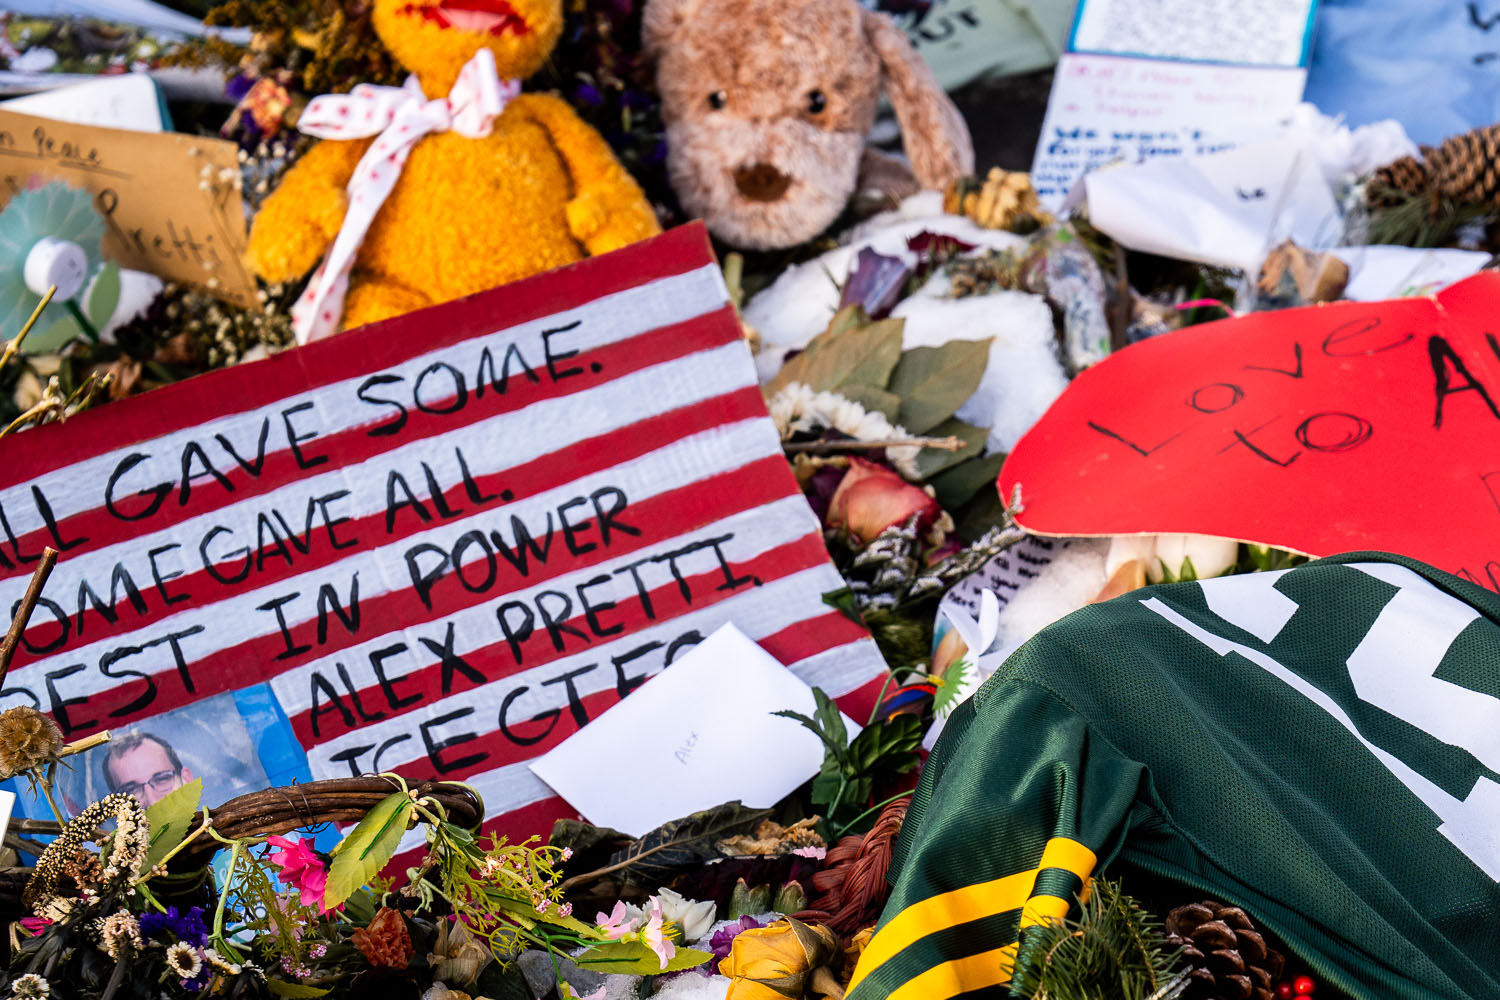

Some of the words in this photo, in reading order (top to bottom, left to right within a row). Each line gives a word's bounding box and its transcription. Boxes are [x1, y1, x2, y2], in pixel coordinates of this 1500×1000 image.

[105, 401, 330, 522] GAVE
[357, 320, 604, 437] SOME.
[200, 489, 360, 586] GAVE
[386, 446, 515, 534] ALL.
[255, 570, 361, 662] IN
[405, 486, 642, 612] POWER
[310, 621, 488, 738] ALEX
